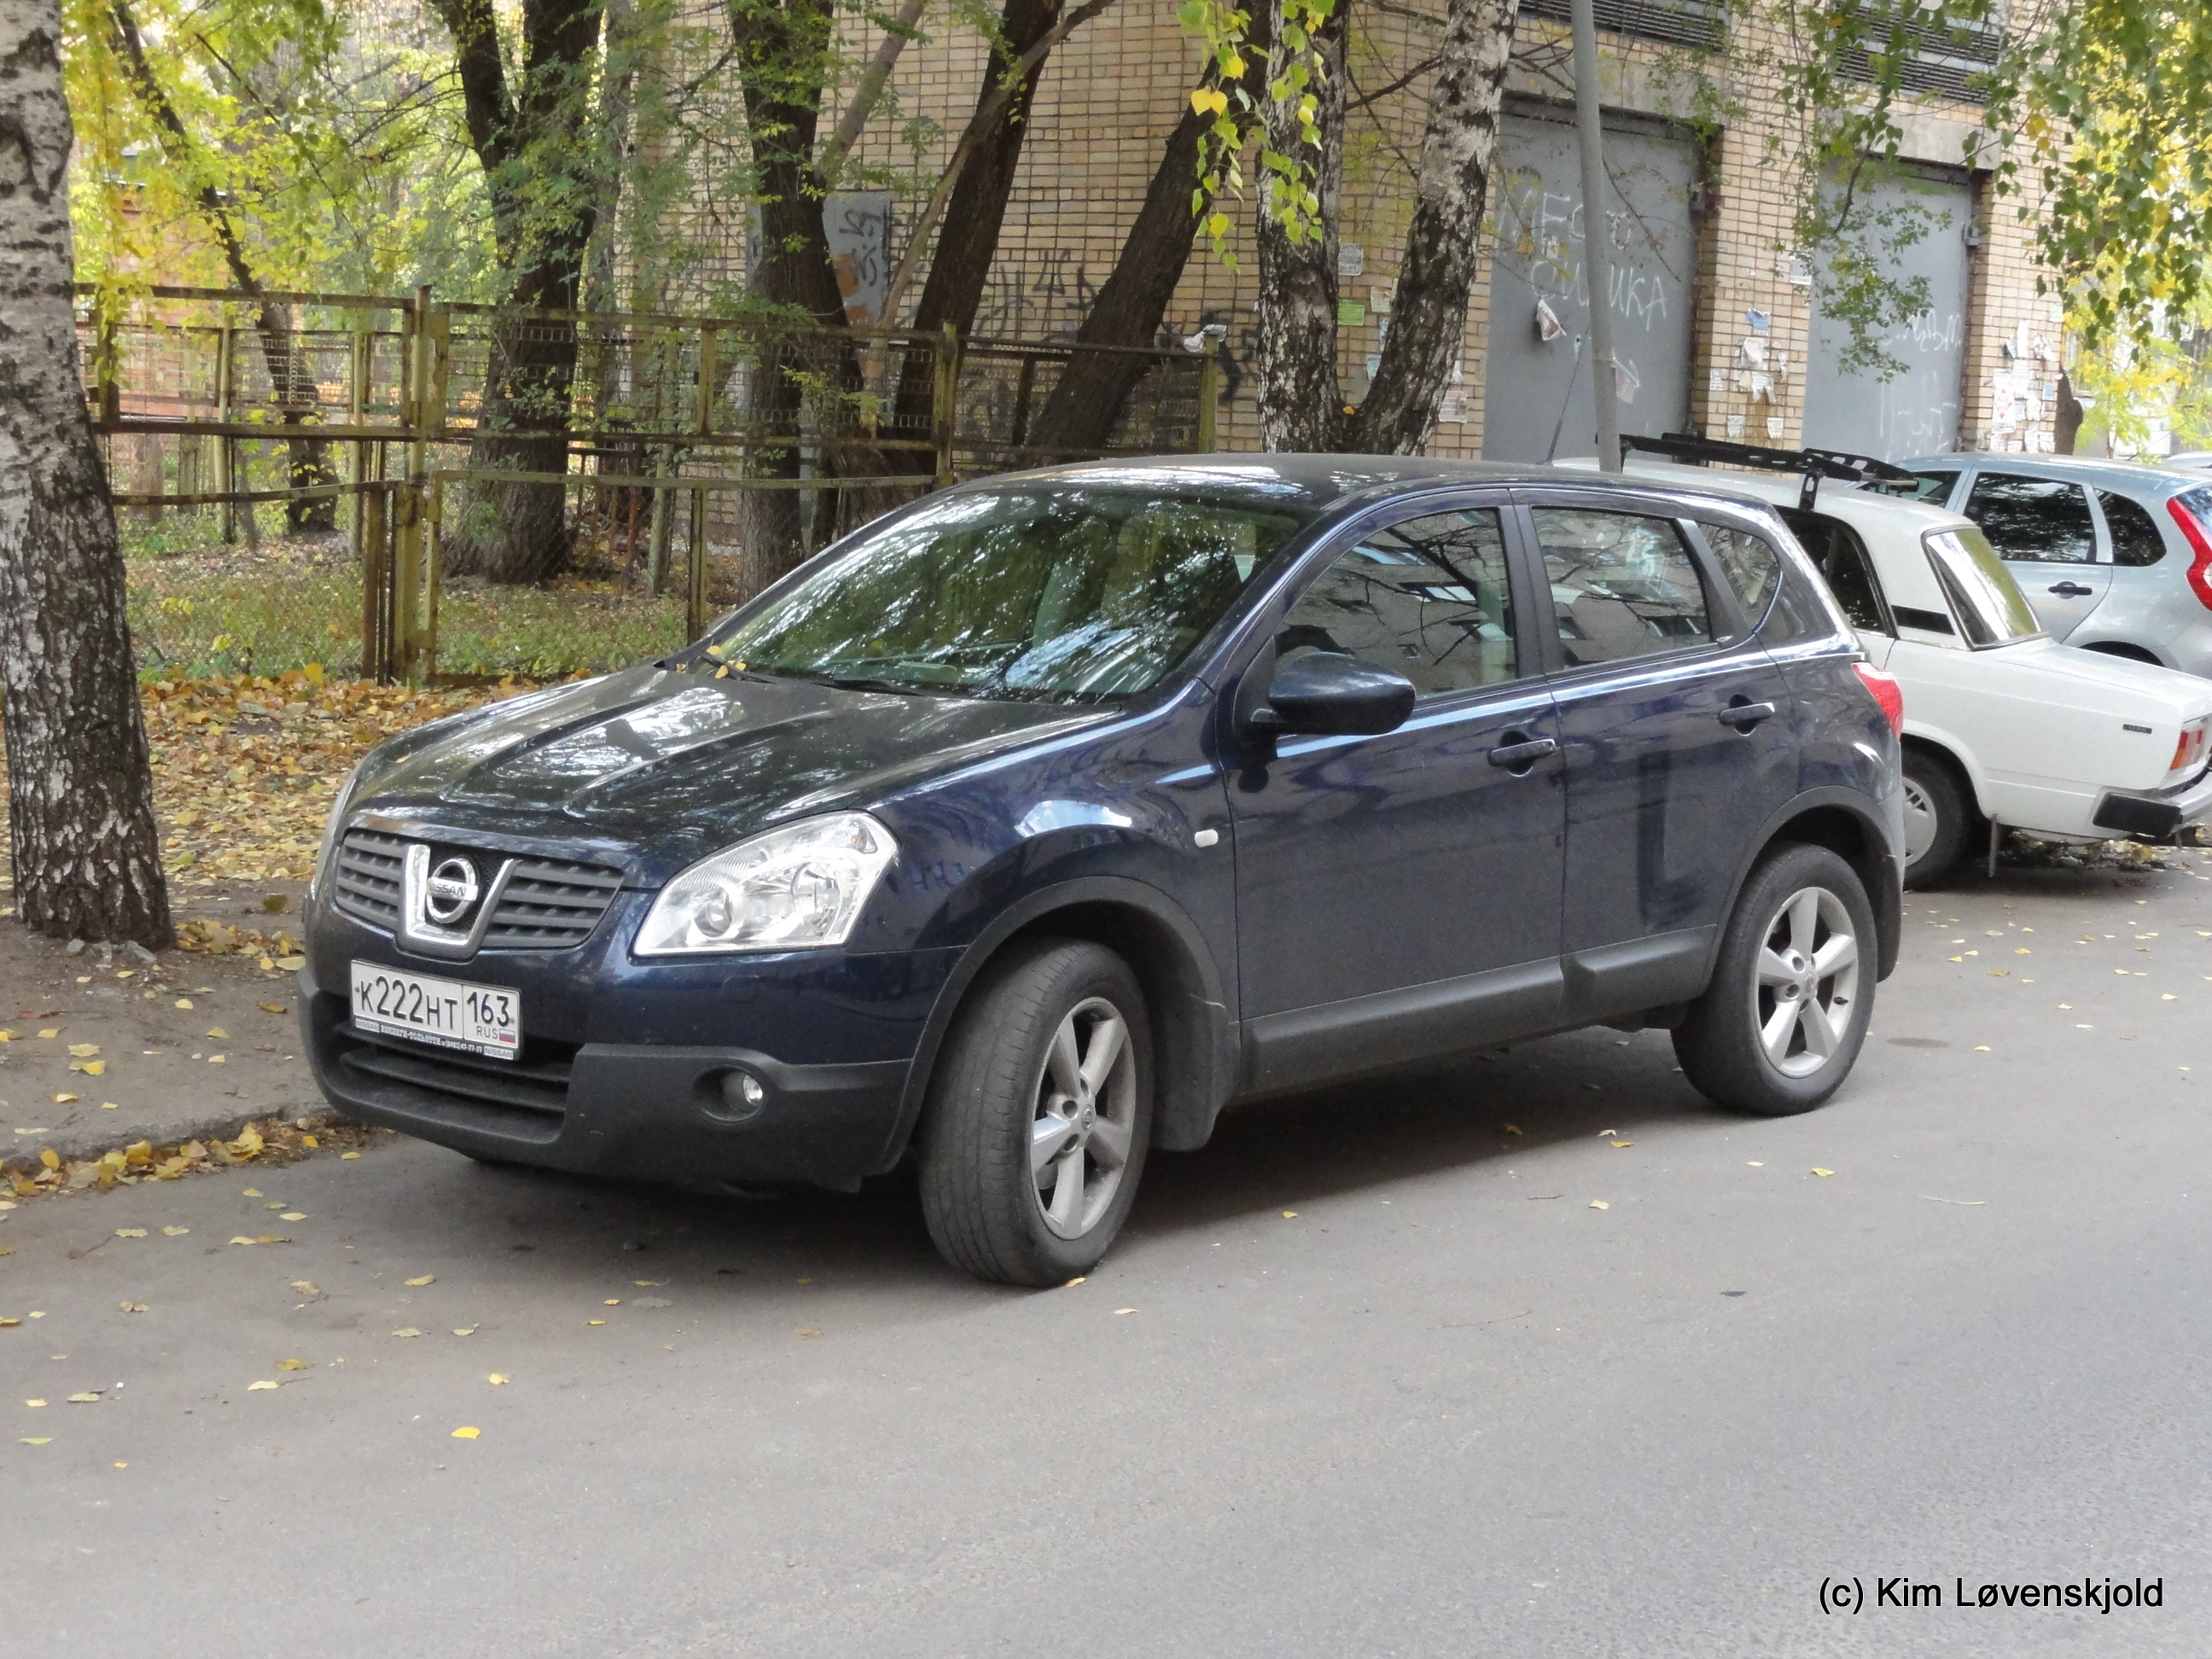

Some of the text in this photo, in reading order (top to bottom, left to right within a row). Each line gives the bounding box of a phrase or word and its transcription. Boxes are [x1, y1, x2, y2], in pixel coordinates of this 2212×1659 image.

[428, 882, 467, 896] NISSAN
[467, 991, 509, 1027] 163
[476, 1026, 498, 1039] RUS
[484, 1046, 513, 1059] NISSAN
